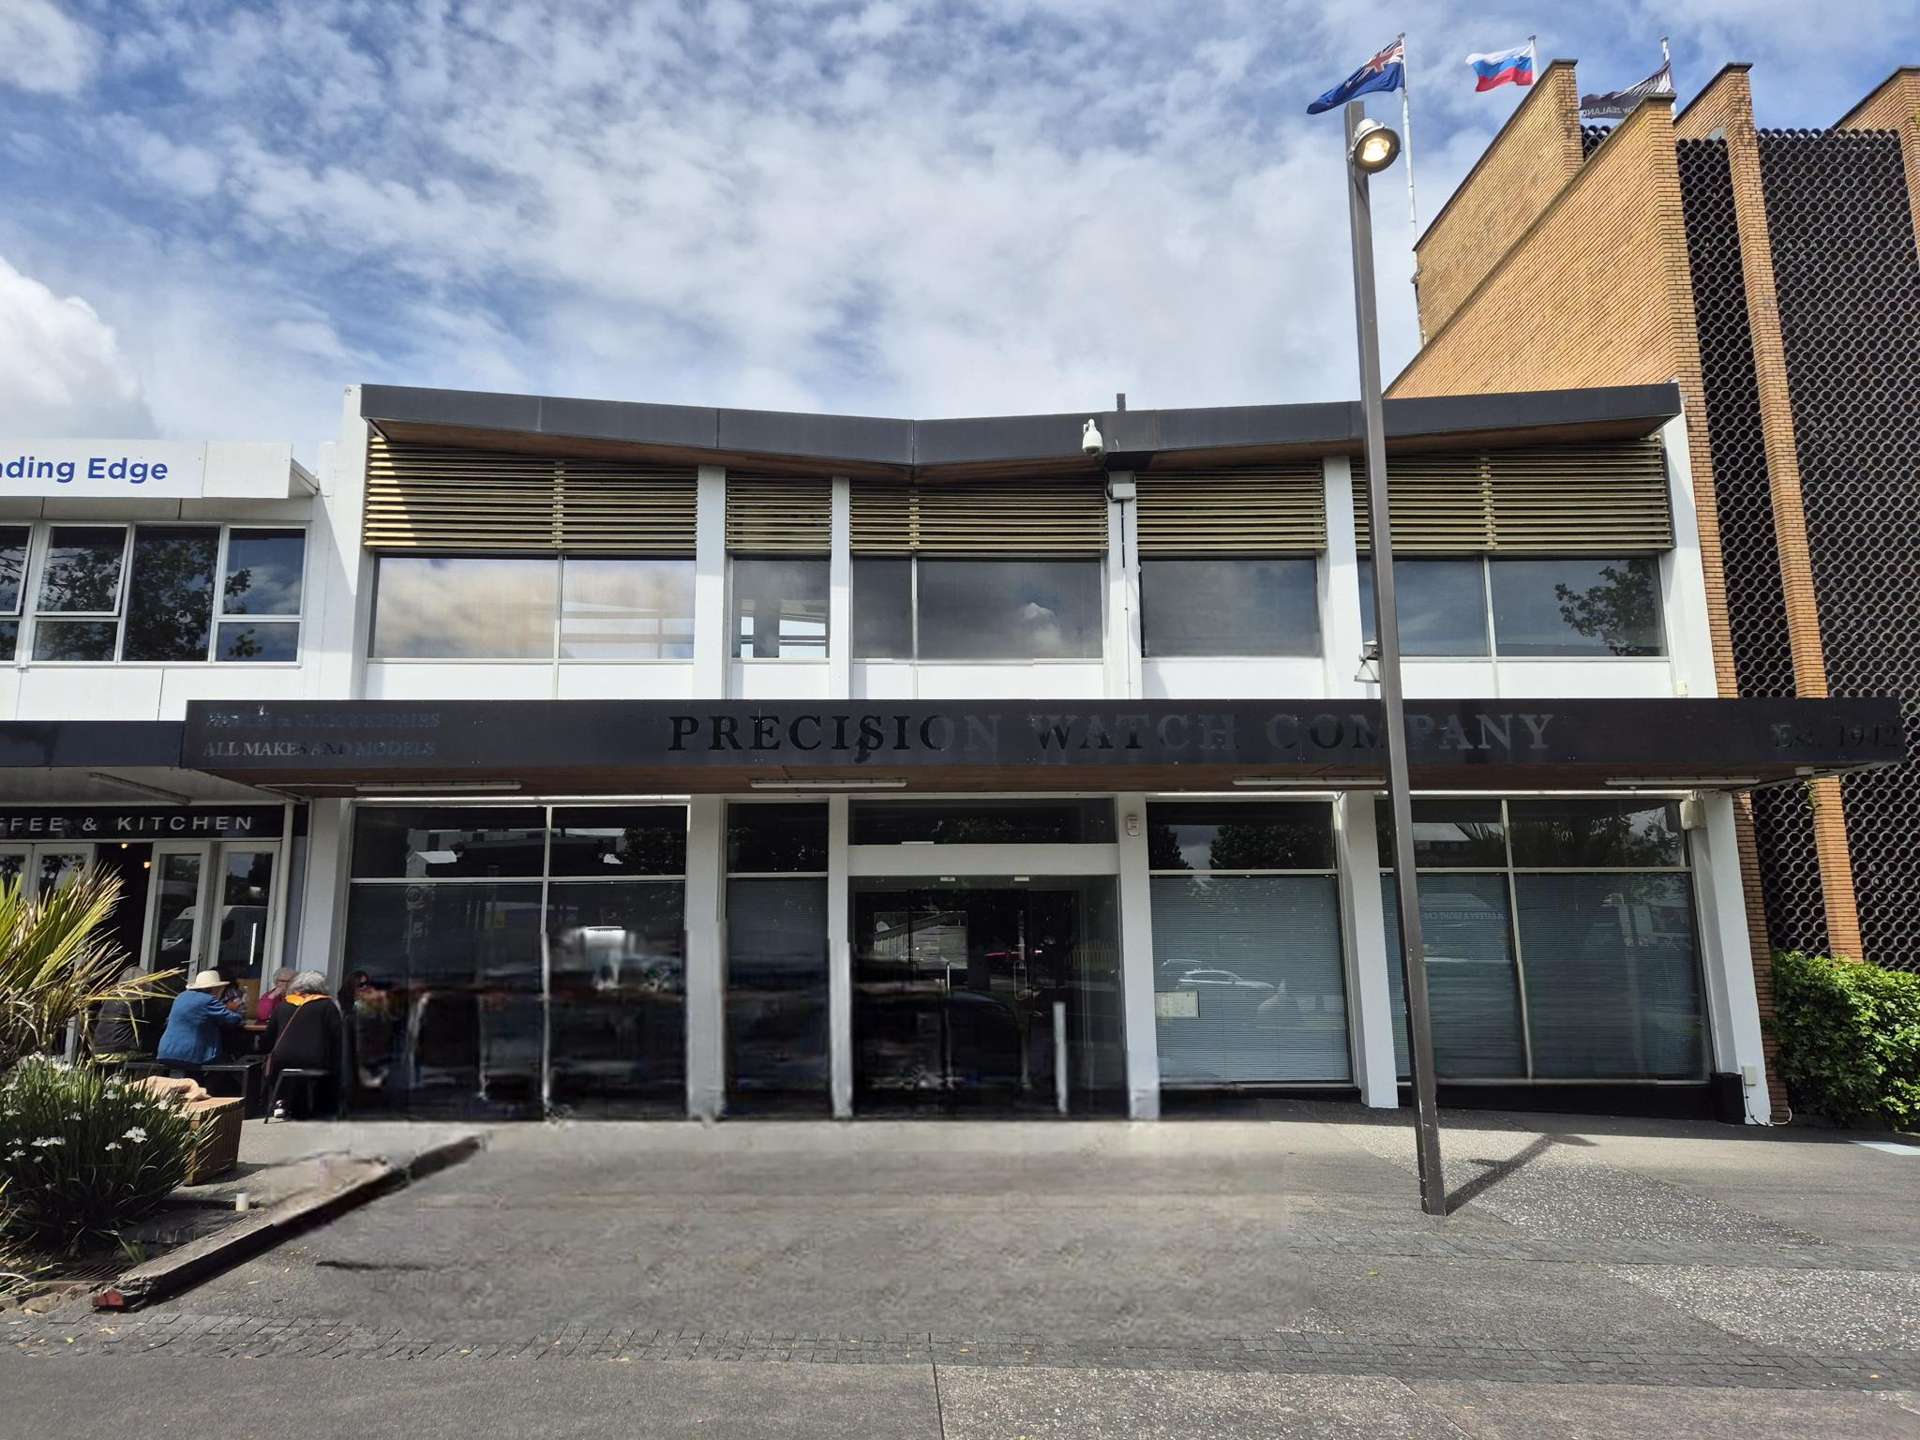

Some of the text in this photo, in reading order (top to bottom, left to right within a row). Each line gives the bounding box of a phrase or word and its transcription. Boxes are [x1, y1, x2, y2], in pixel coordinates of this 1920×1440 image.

[0, 456, 168, 484] ding Edge
[667, 713, 1555, 752] PRECISION WATCH COMPANY
[202, 741, 240, 757] ALL
[242, 741, 308, 757] MAKES
[353, 741, 436, 757] MODELS
[81, 816, 97, 832] &
[117, 815, 252, 832] KITCHEN
